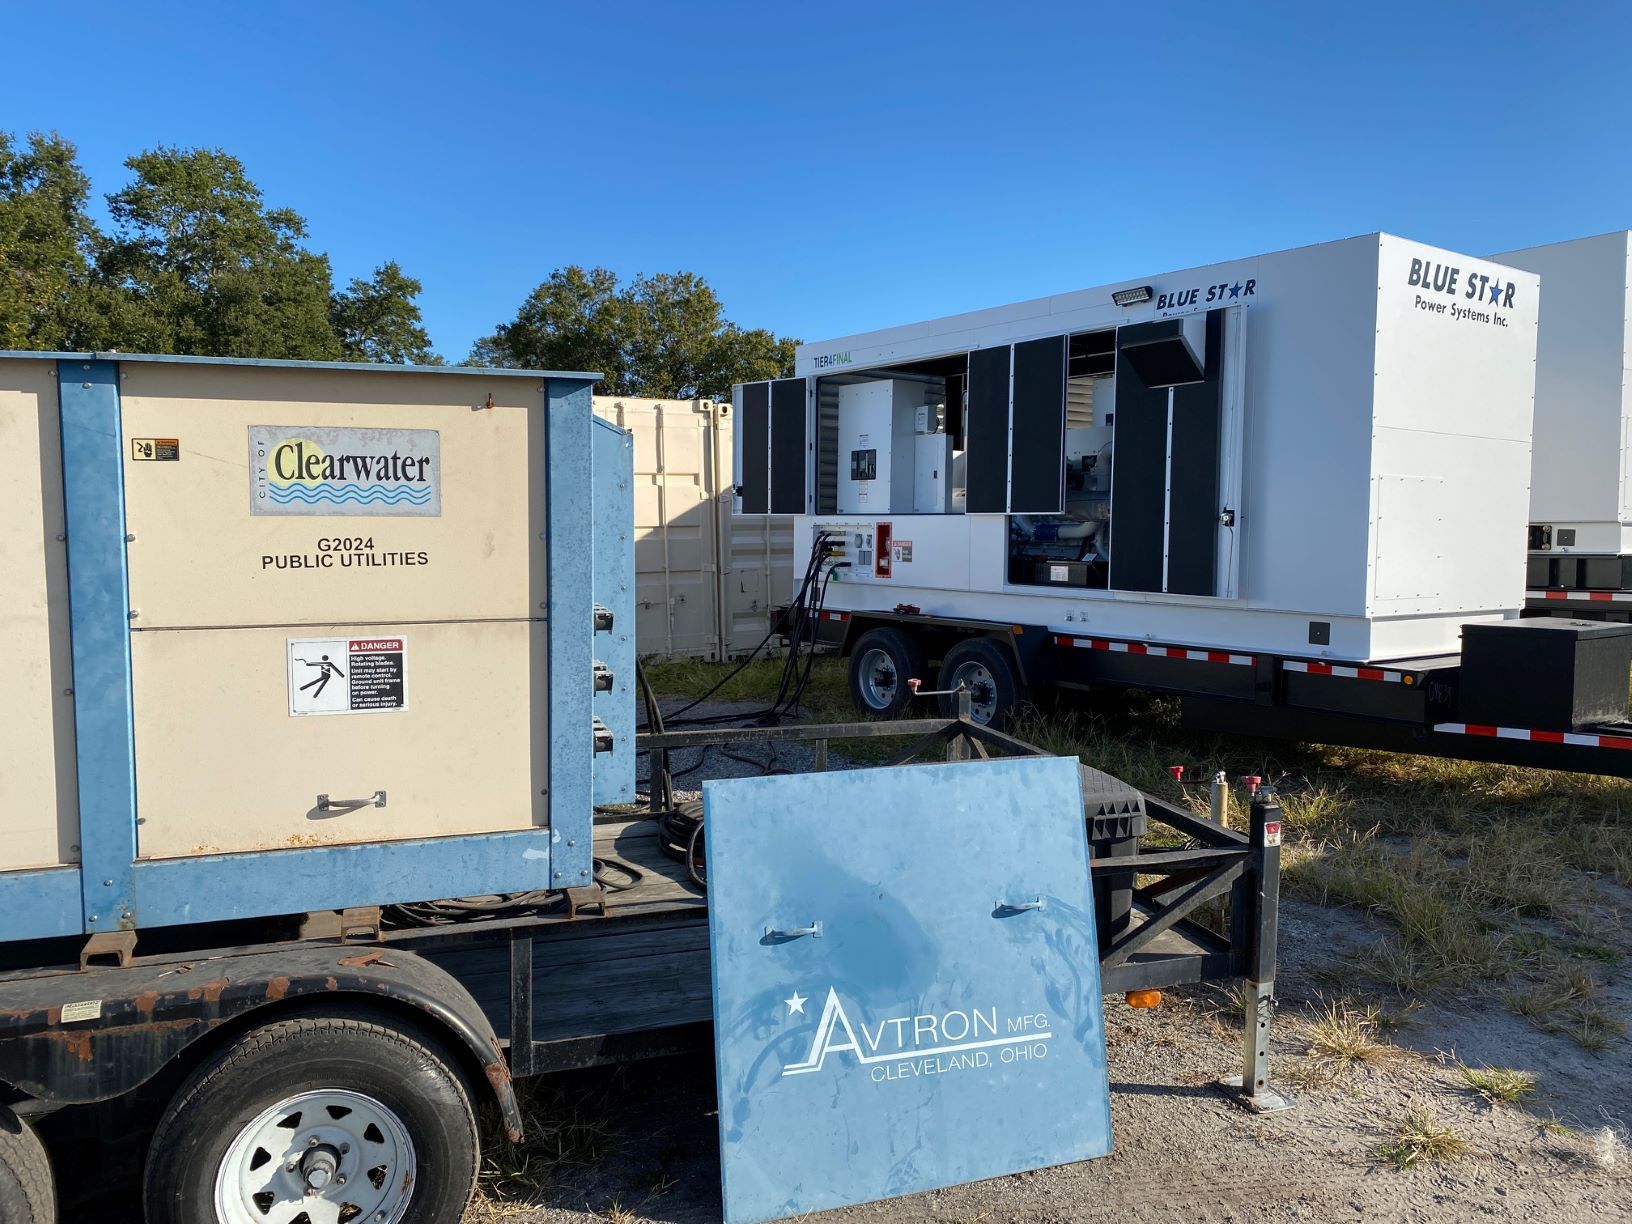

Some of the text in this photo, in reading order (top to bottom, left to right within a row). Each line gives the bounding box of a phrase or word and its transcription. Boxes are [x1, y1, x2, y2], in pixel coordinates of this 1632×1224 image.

[1408, 257, 1460, 295] BLUE
[1156, 288, 1200, 310] BLUE
[1415, 294, 1508, 328] Power Systems Inc.
[257, 440, 266, 499] CITY OF
[274, 441, 430, 483] Clearwater
[262, 552, 429, 570] PUBLIC UTILITIES
[317, 537, 375, 552] G2024
[361, 641, 399, 650] DANGER
[806, 985, 1051, 1066] AVTRON MFG.
[870, 1043, 1049, 1082] CLEVELAND, OHIO
